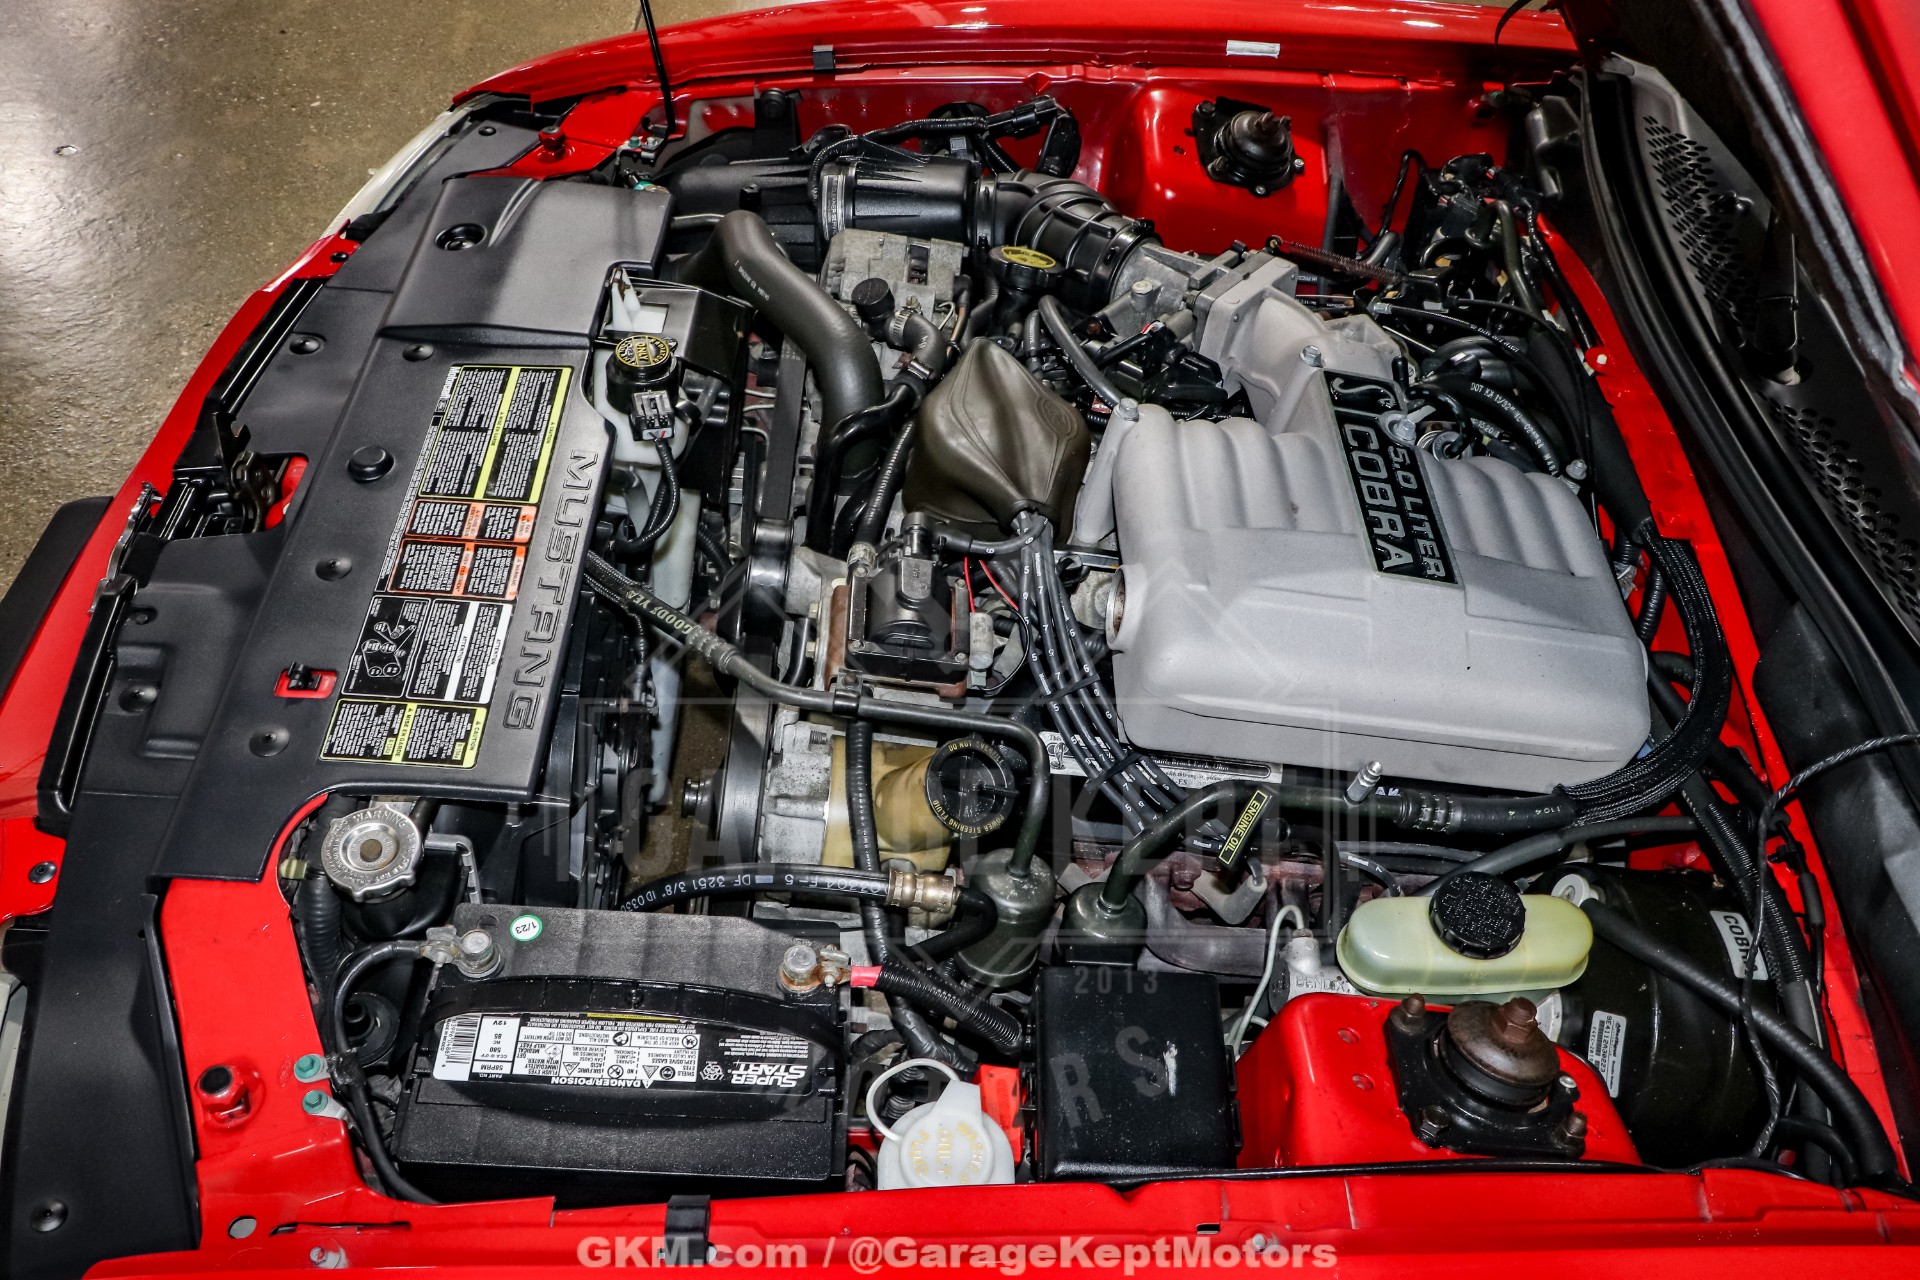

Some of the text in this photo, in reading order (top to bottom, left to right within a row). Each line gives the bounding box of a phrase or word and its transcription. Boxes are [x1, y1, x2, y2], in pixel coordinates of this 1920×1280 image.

[635, 342, 647, 359] ONLY
[443, 366, 460, 400] Motorcraft
[545, 426, 554, 444] CAUTION
[1345, 422, 1414, 572] COBRA
[1387, 442, 1445, 581] 5.0 LITER
[502, 450, 598, 731] MUSTANG
[394, 713, 410, 757] MISE EN GARDE
[469, 726, 479, 750] CAUTION
[352, 810, 405, 826] WARNING
[932, 799, 1004, 833] POWER STEERING FLUID
[1224, 799, 1260, 853] ENGINE OIL
[691, 875, 724, 890] 3251
[733, 873, 750, 884] DF
[645, 890, 655, 900] ID
[661, 882, 686, 896] 3/8"
[515, 921, 536, 934] 1/23
[1722, 911, 1755, 968] COBR
[730, 1063, 807, 1078] START
[550, 1075, 641, 1088] DANGER/POISON
[730, 1074, 796, 1087] SUPER
